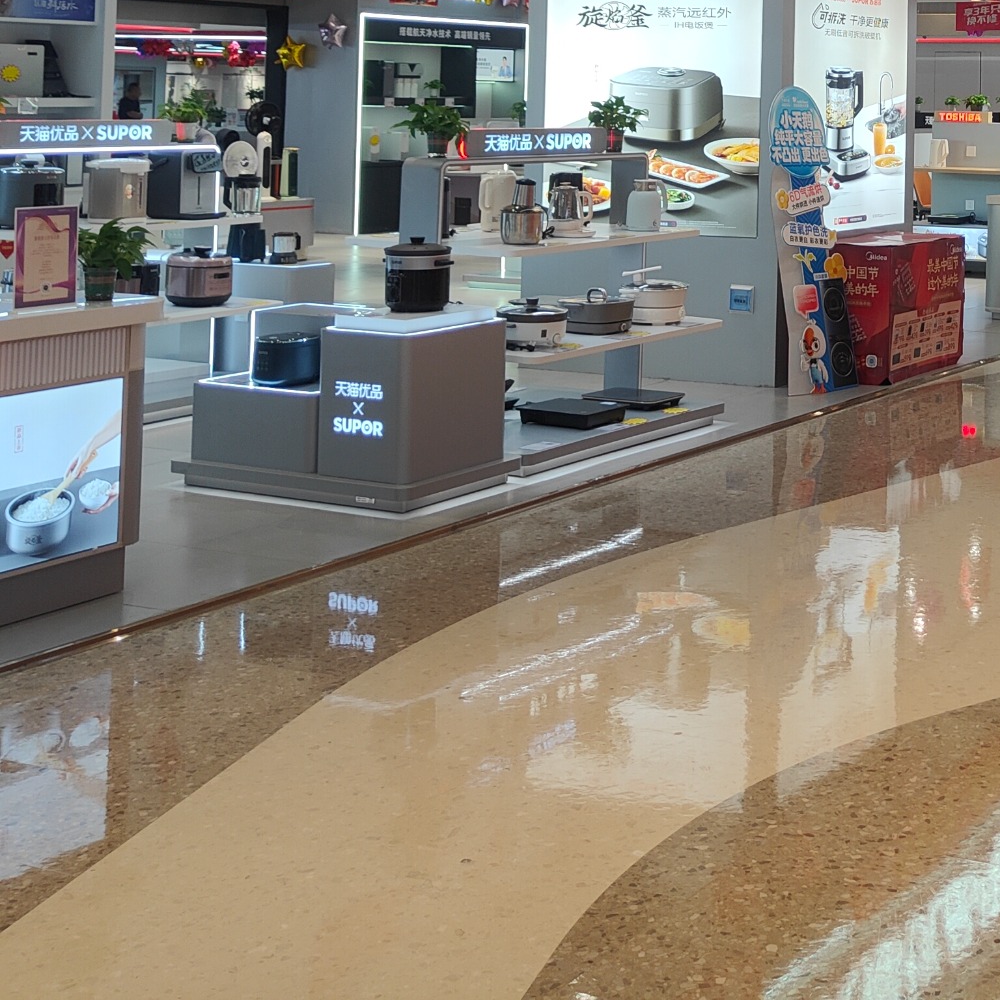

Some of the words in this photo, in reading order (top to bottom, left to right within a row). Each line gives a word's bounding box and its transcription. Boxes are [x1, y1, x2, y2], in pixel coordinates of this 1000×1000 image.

[657, 7, 732, 19] 蒸汽远红外
[963, 4, 1000, 17] 享3年只
[674, 21, 714, 30] IH电饭煲
[849, 15, 890, 28] 干净更健康
[966, 15, 998, 26] 换不修
[780, 110, 814, 130] 小天鹅
[939, 112, 982, 123] TOSHIBA
[19, 125, 79, 142] 天猫优品
[96, 124, 153, 141] SUPOR
[774, 130, 824, 147] 纯平大容量
[484, 133, 533, 152] 天猫优品
[546, 132, 592, 150] SUPOR
[771, 148, 801, 164] 不凸出
[802, 148, 830, 164] 更出色
[865, 252, 888, 261] Midea
[926, 256, 959, 274] 最美中国节
[335, 381, 384, 400] 天猫优品
[333, 416, 384, 437] SUPOR
